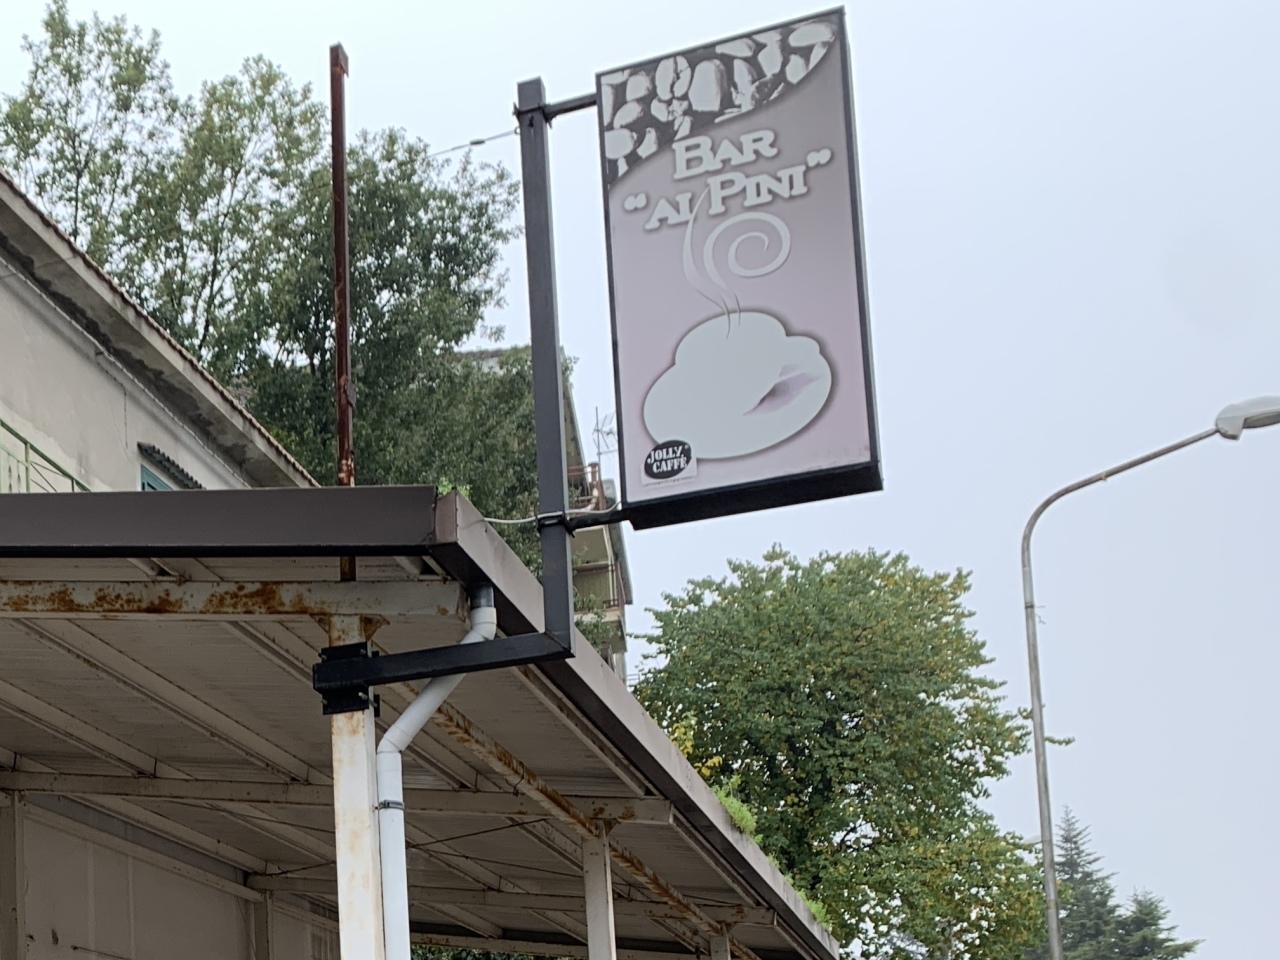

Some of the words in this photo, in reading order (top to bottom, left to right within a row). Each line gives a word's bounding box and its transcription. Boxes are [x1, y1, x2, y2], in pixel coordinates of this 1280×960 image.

[672, 129, 778, 179] BAR
[647, 445, 683, 464] JOLLY
[652, 453, 688, 474] CAFFÈ
